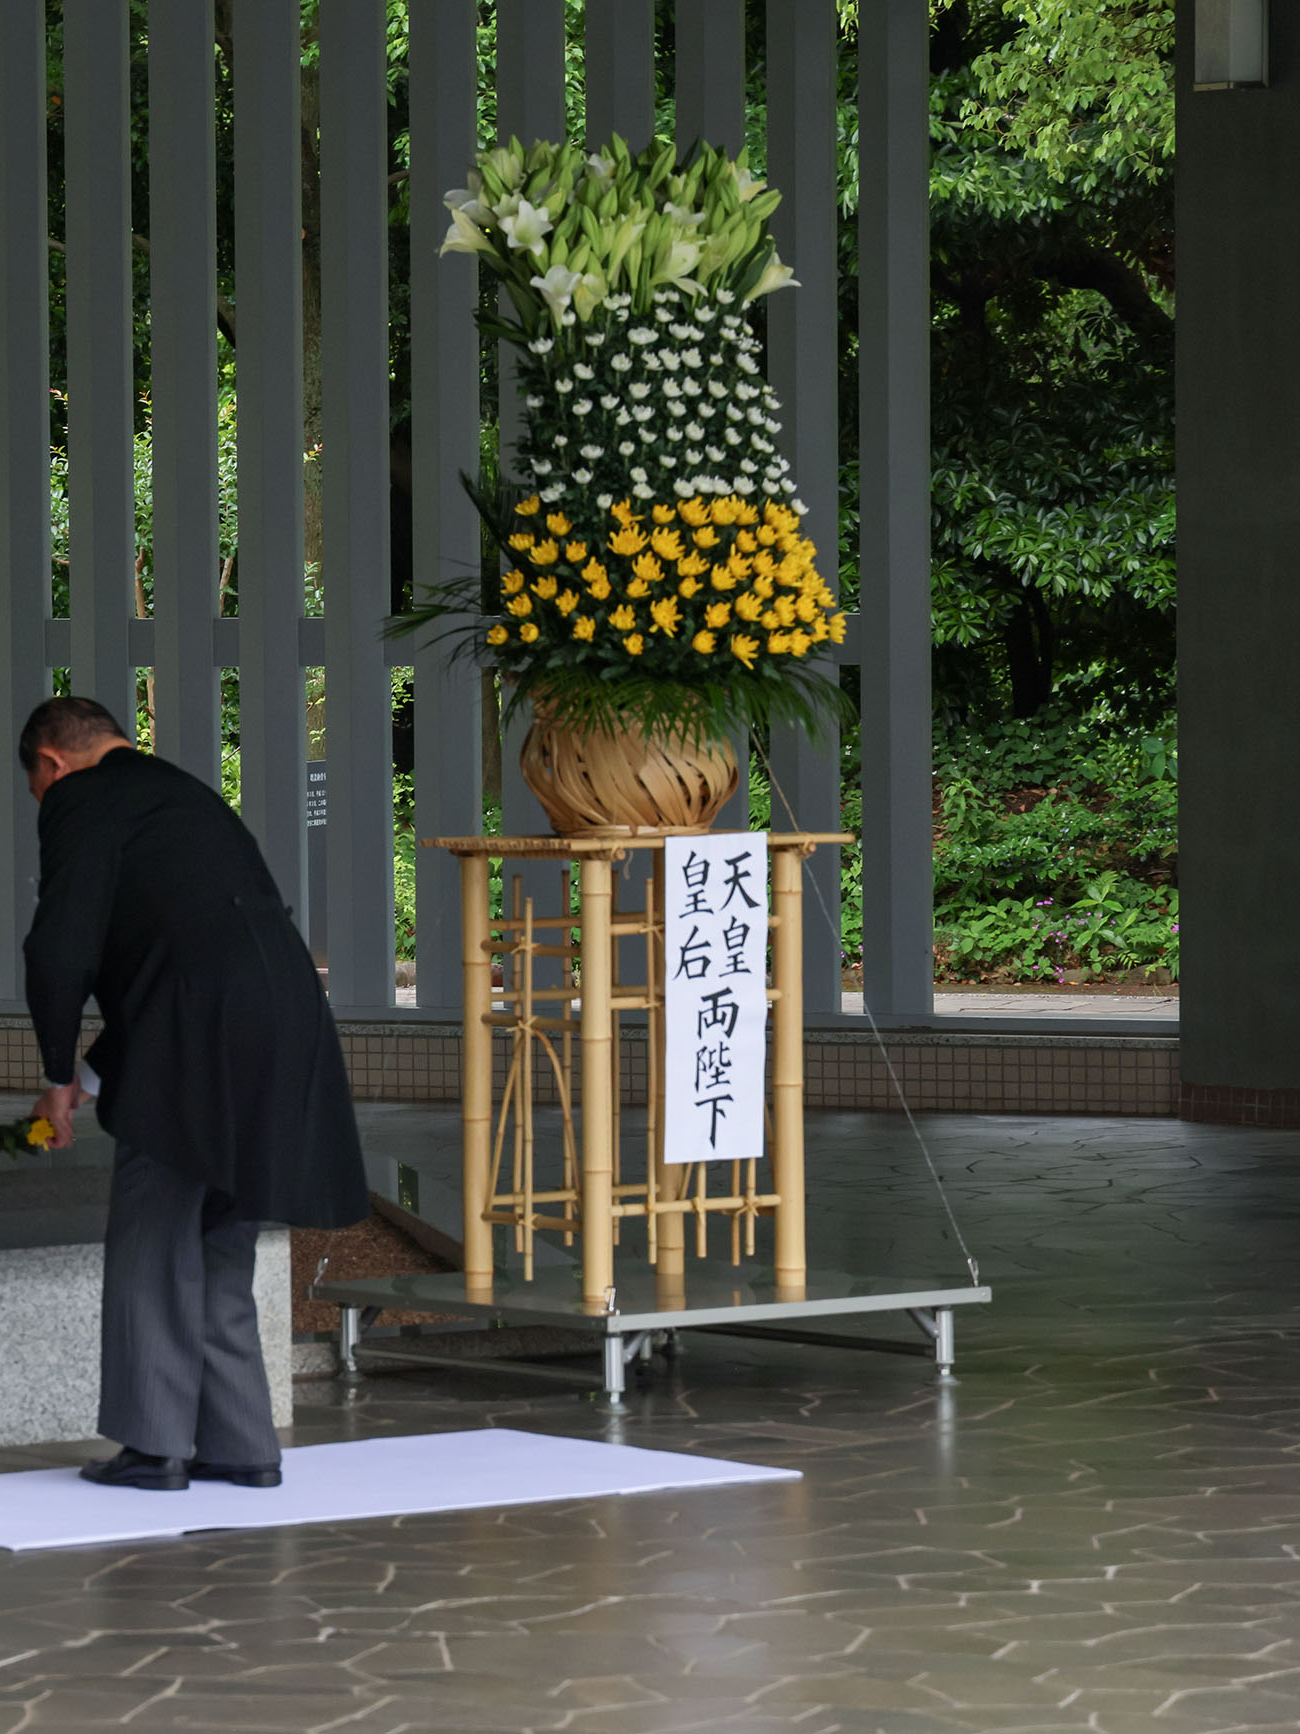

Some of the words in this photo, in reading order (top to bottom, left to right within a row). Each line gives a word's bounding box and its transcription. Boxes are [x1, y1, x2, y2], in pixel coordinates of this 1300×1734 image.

[673, 850, 714, 980] 皇后
[720, 851, 761, 978] 天皇
[694, 986, 740, 1149] 両陛下
